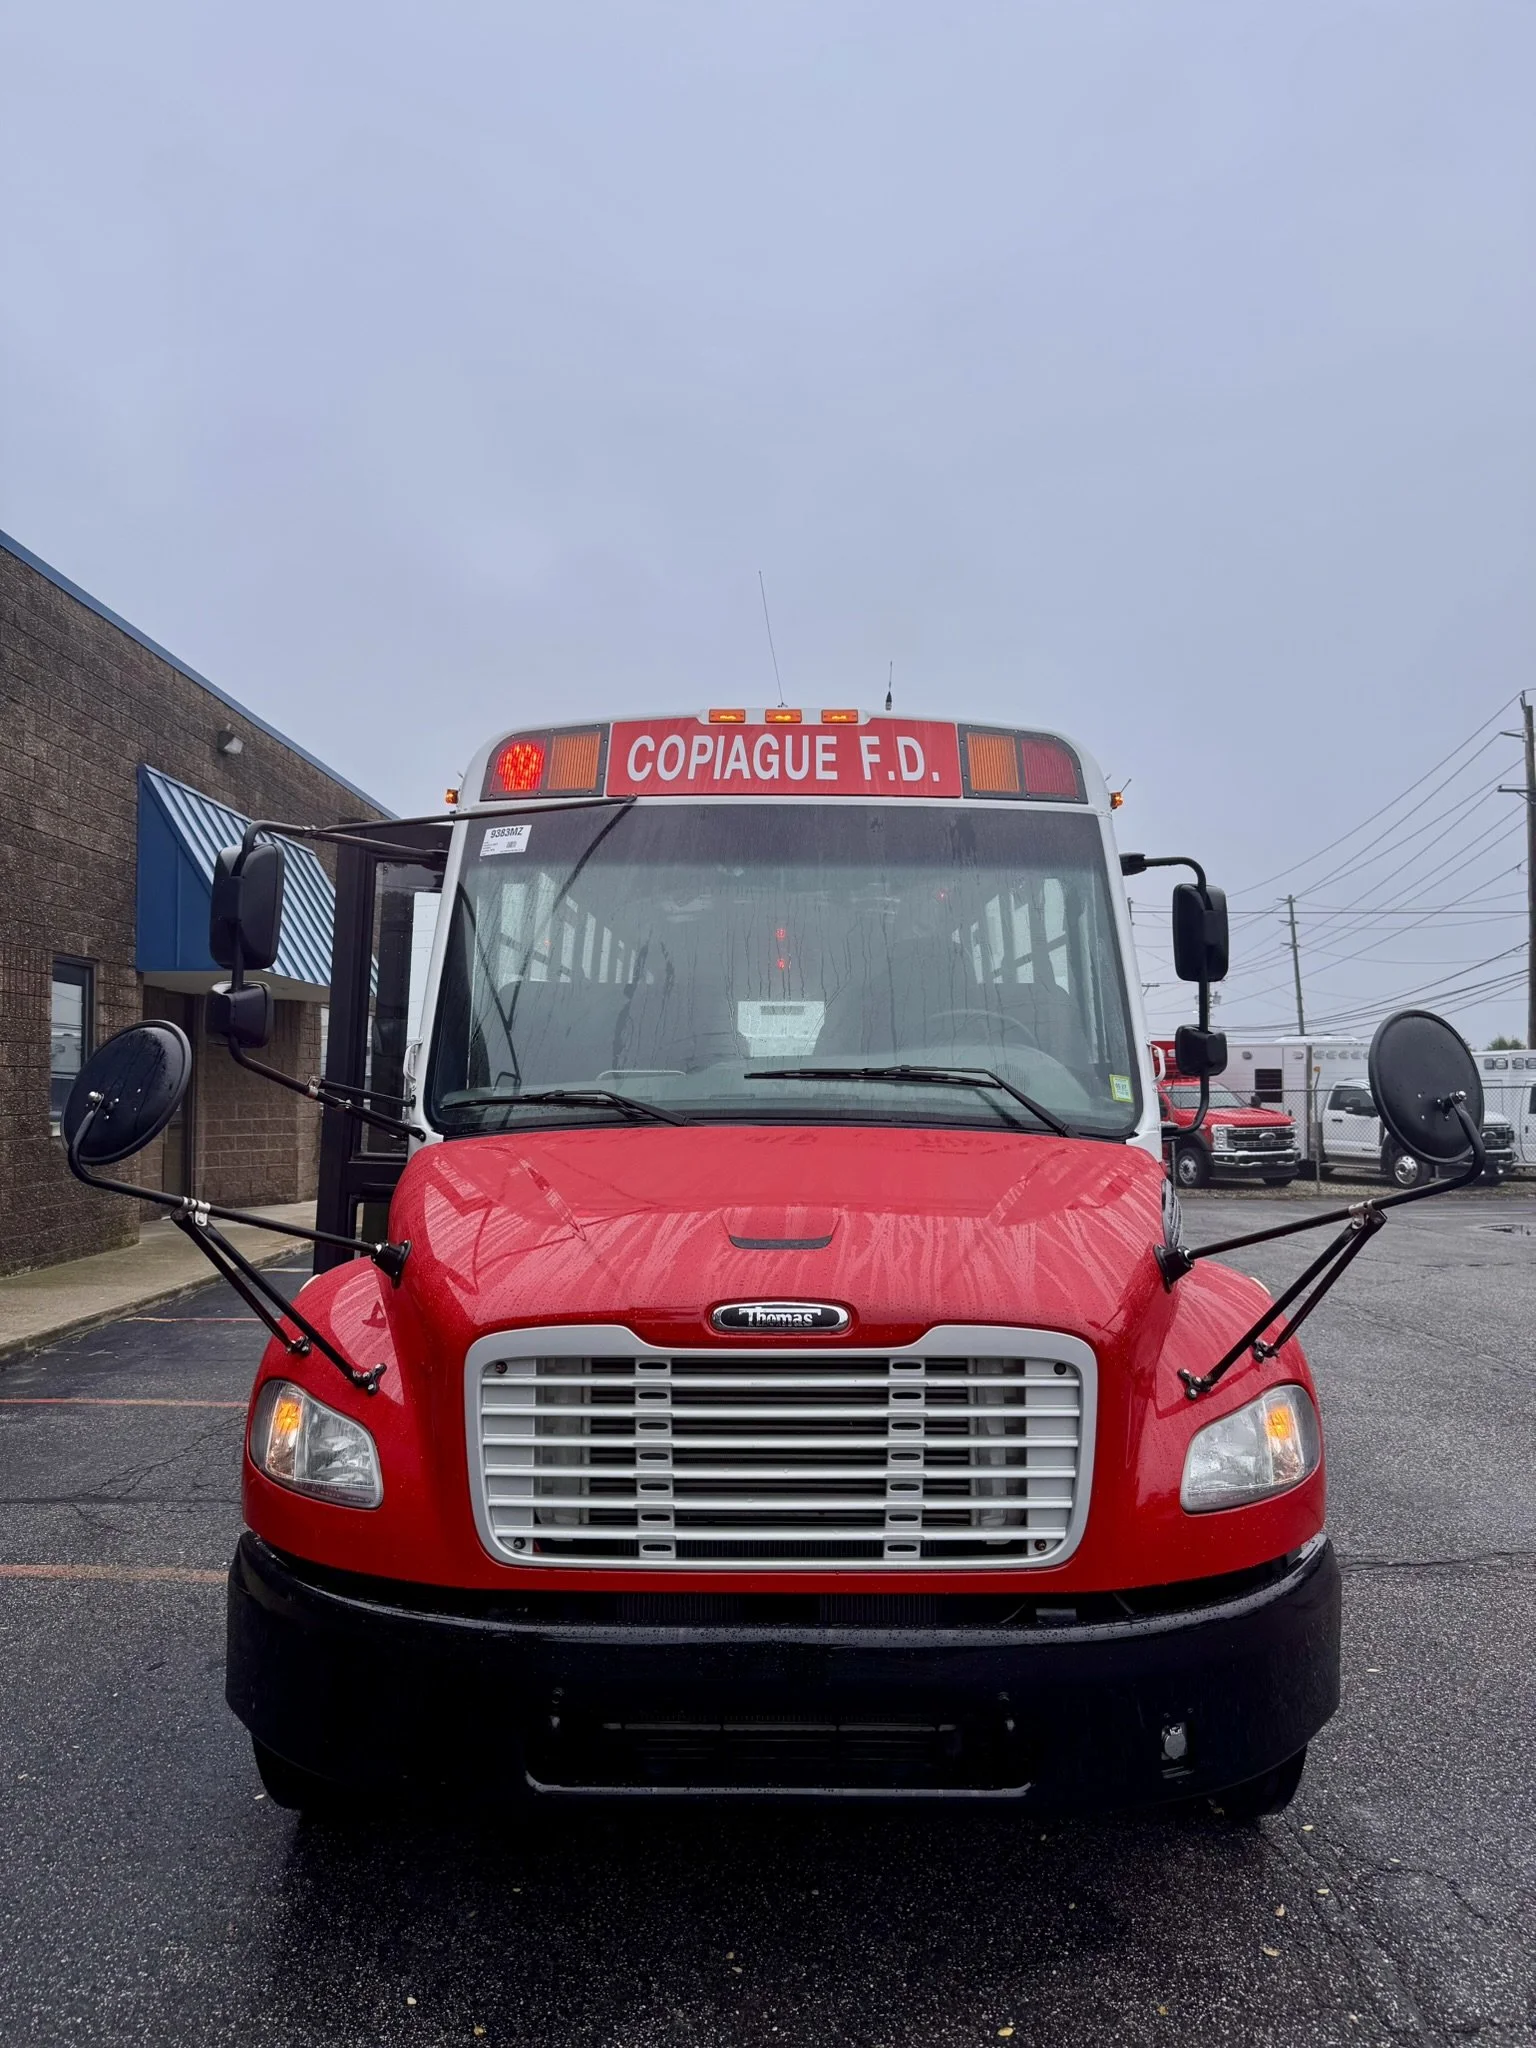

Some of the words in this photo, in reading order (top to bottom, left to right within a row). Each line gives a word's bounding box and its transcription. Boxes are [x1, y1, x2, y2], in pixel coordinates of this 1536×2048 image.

[627, 734, 838, 782] COPIAGUE
[859, 735, 940, 782] F.D.
[490, 827, 524, 838] 9383MZ
[738, 1307, 822, 1327] Thomas
